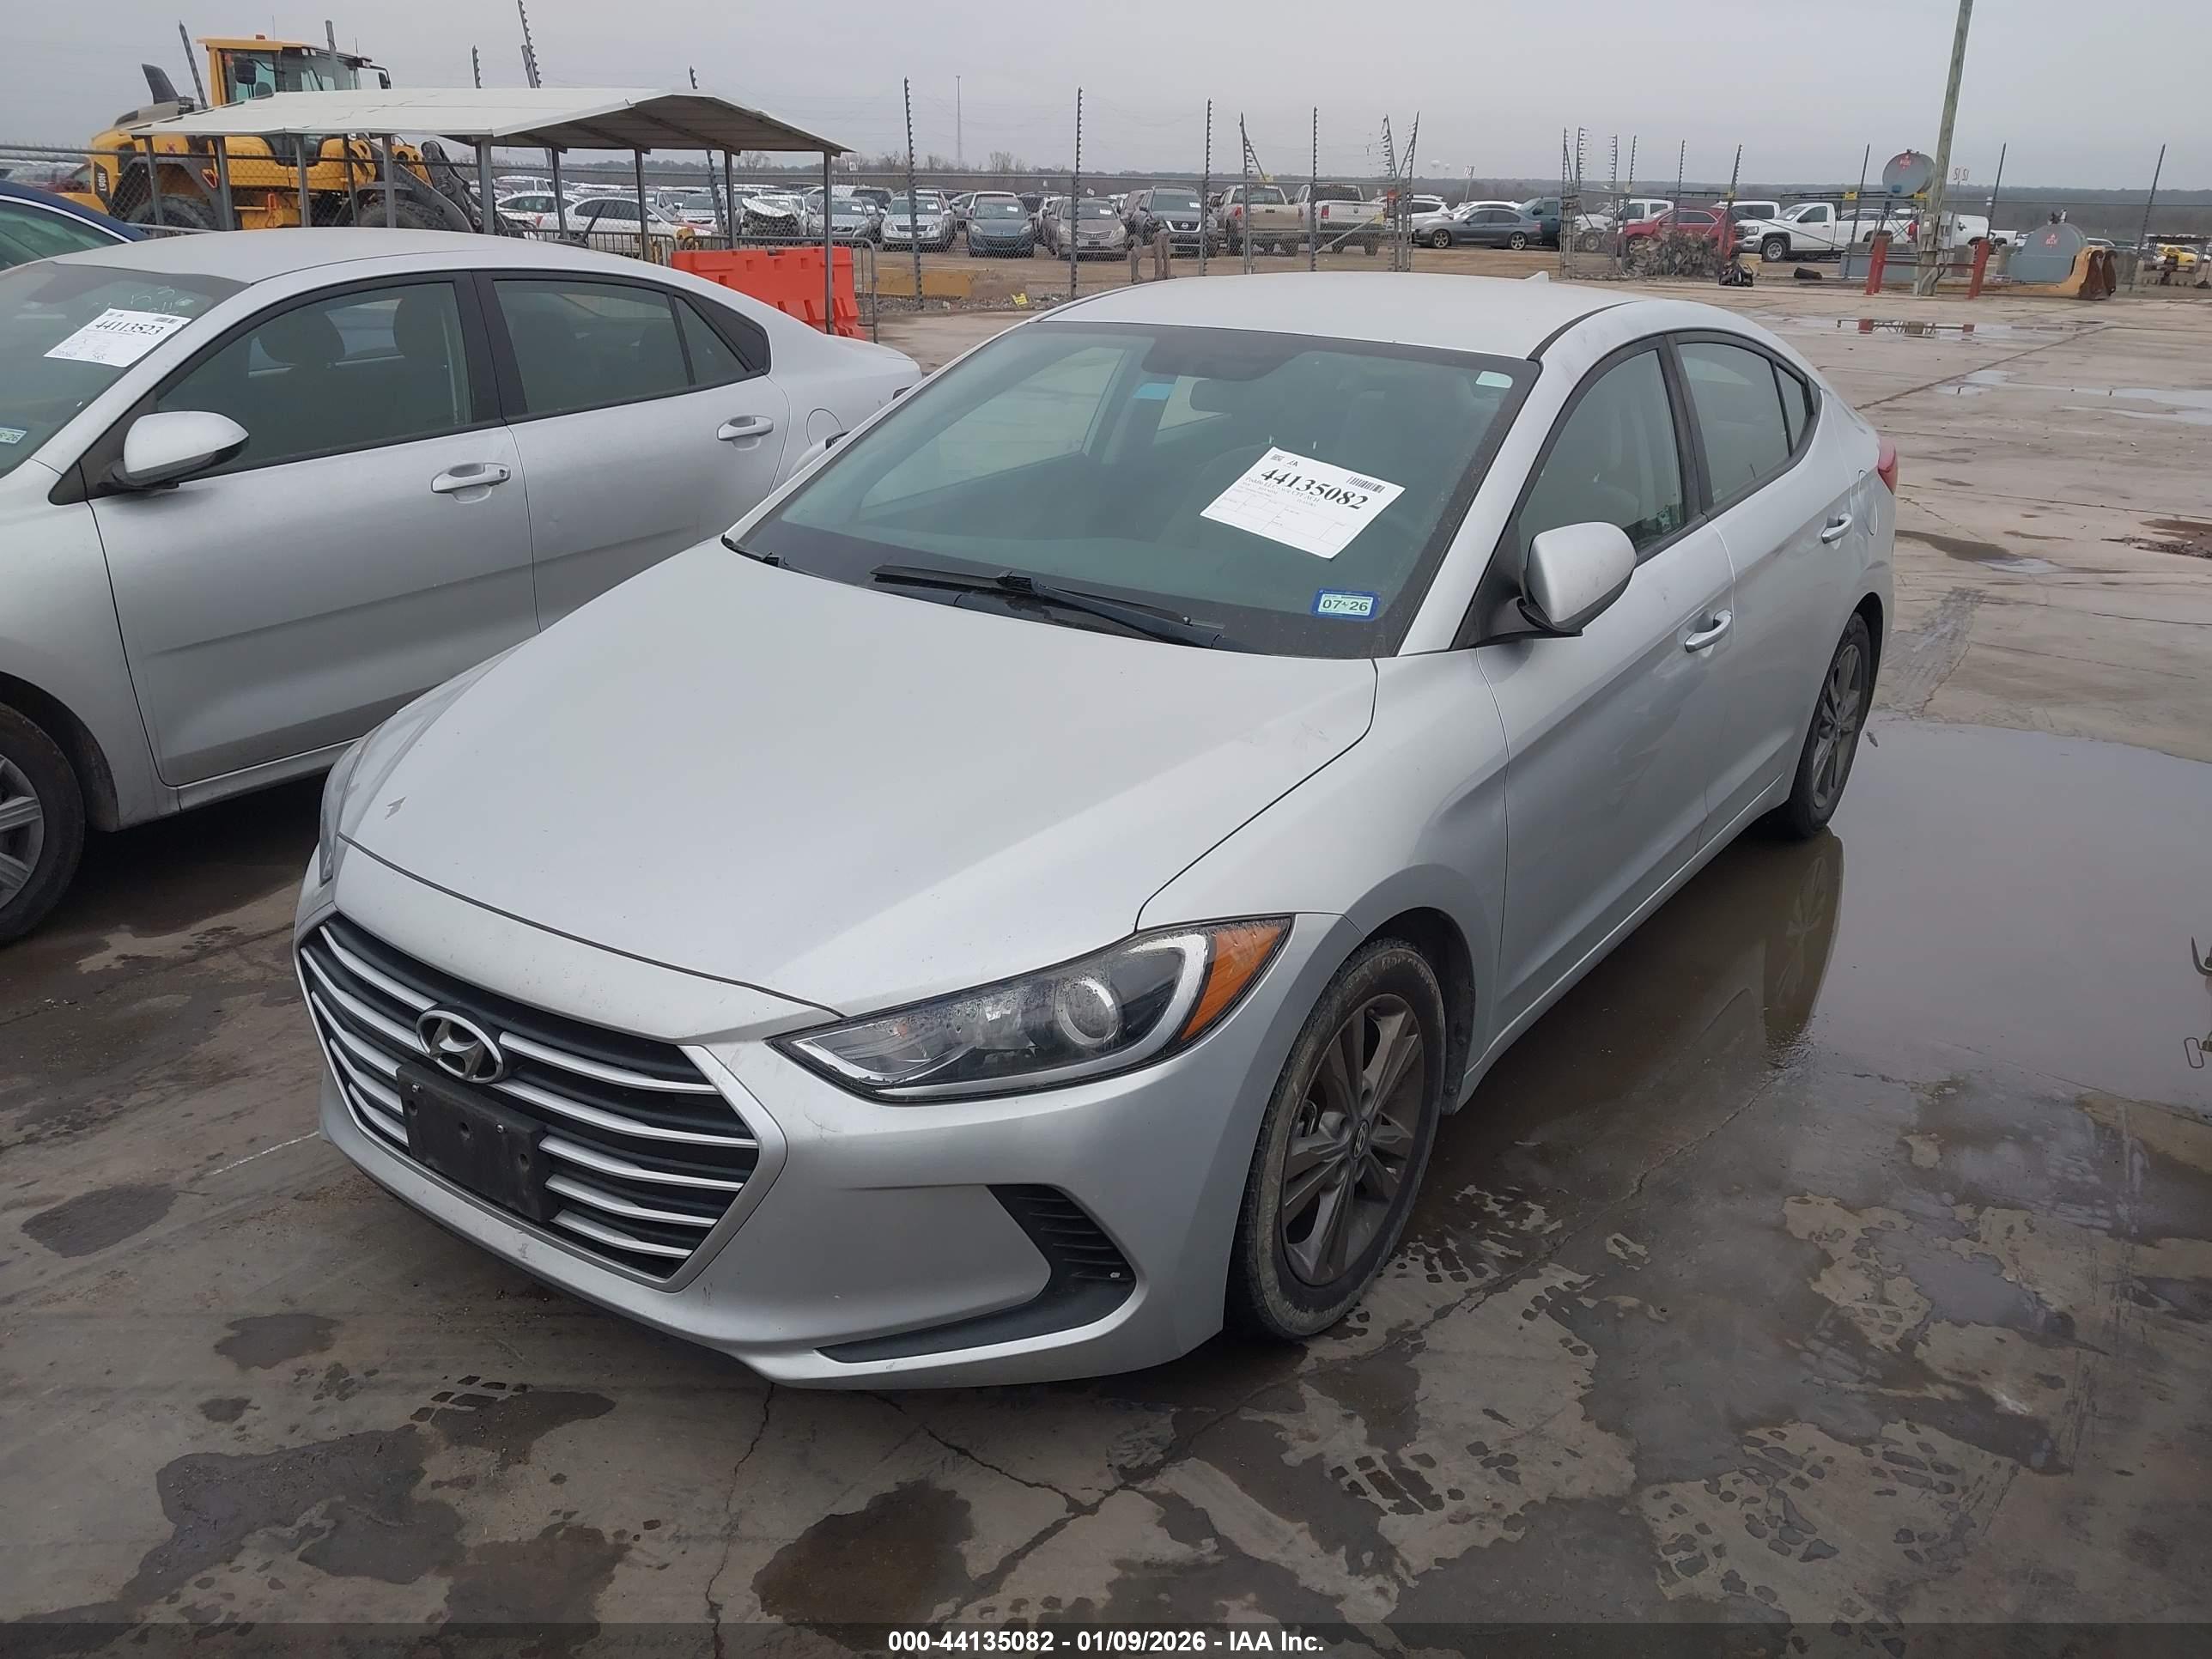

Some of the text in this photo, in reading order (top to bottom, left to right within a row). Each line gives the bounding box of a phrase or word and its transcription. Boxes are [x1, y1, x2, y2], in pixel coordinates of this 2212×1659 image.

[97, 173, 107, 191] L90H
[95, 319, 165, 336] 44113523
[1261, 467, 1369, 510] 44135082
[1322, 599, 1369, 611] 07 26
